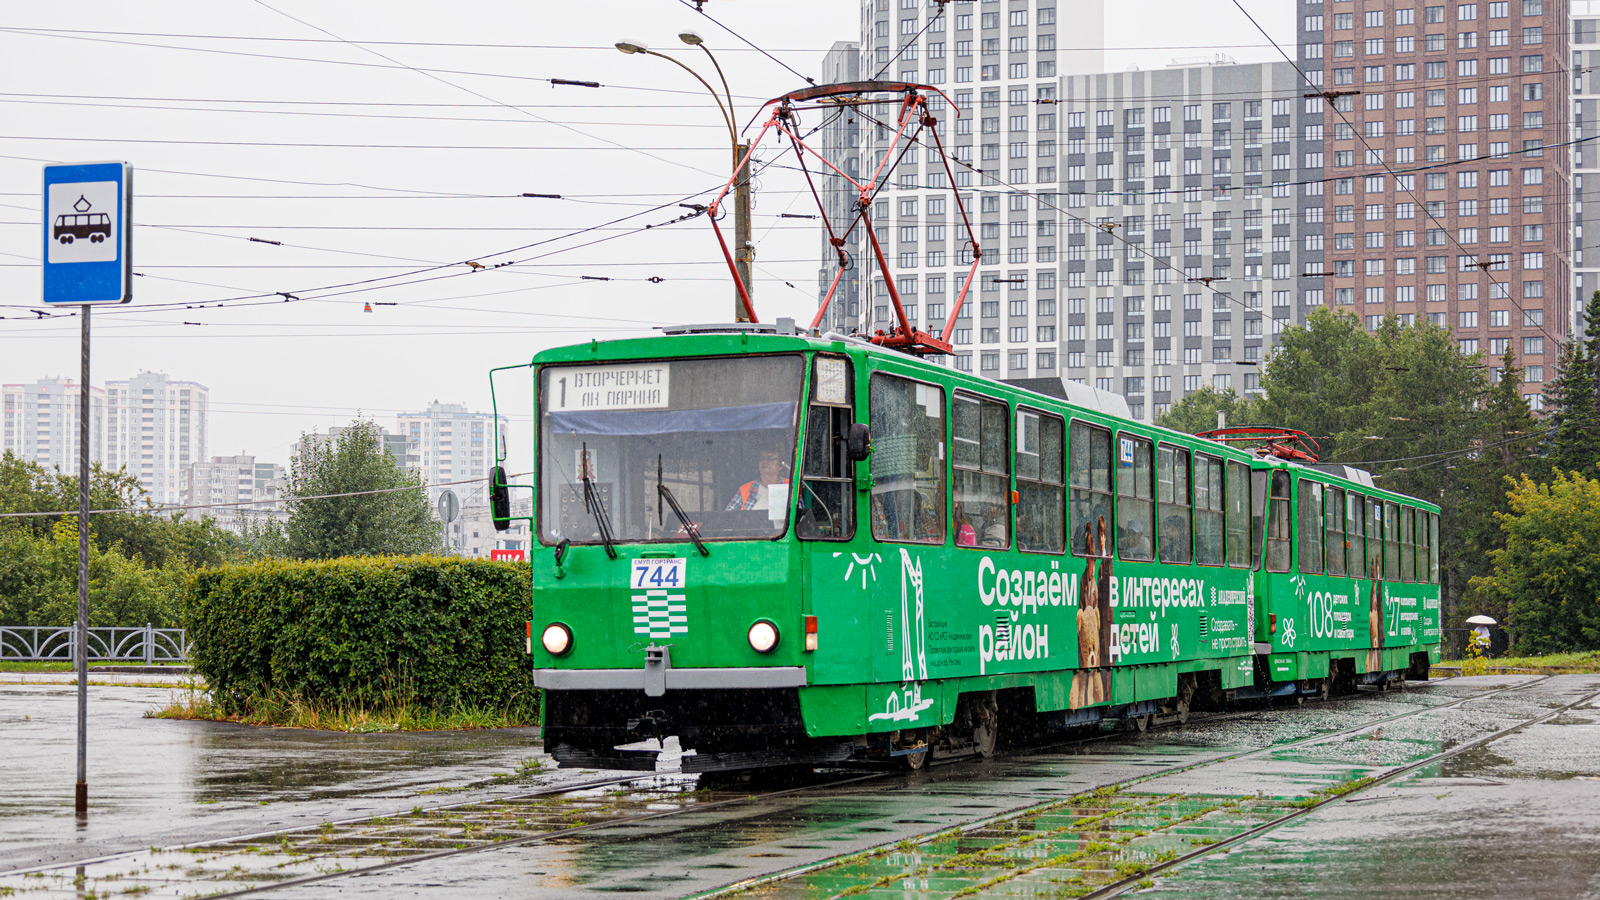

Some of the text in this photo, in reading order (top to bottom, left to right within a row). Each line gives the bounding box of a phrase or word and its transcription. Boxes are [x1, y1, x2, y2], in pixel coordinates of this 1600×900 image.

[558, 377, 566, 408] 1
[574, 369, 662, 388] ВТОРЧЕРМЕТ
[1121, 440, 1132, 461] 744
[636, 566, 679, 587] 744
[978, 556, 1205, 618] Создаём в интересах
[1307, 590, 1334, 638] 108
[1388, 596, 1400, 636] 27
[979, 610, 1159, 675] район детей
[1212, 638, 1218, 650] не
